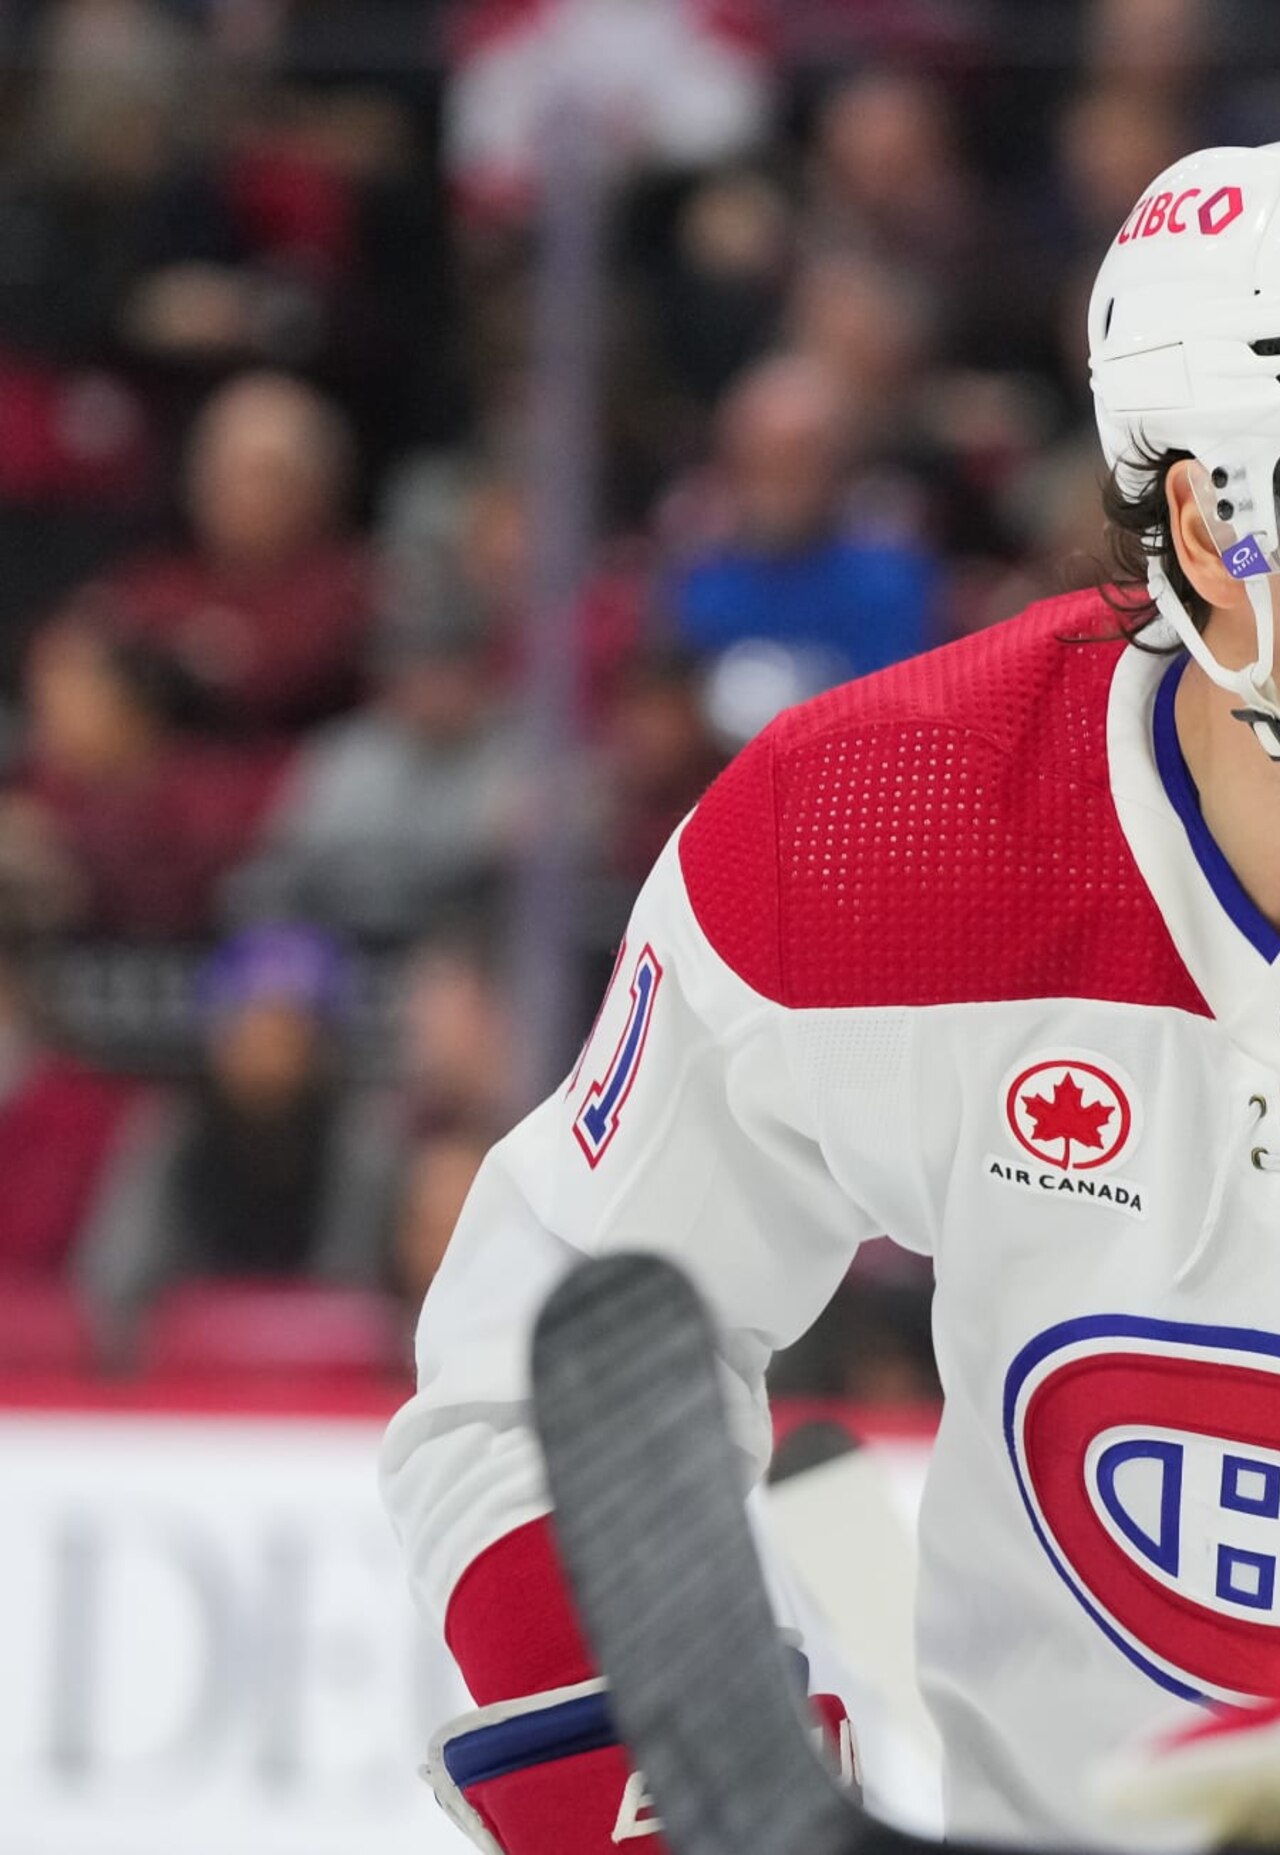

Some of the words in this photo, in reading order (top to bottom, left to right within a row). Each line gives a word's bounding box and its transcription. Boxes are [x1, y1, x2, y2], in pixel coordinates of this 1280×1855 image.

[1117, 188, 1202, 246] CIBC
[563, 936, 663, 1170] 1
[989, 1163, 1030, 1186] AIR
[1038, 1174, 1143, 1212] CANADA
